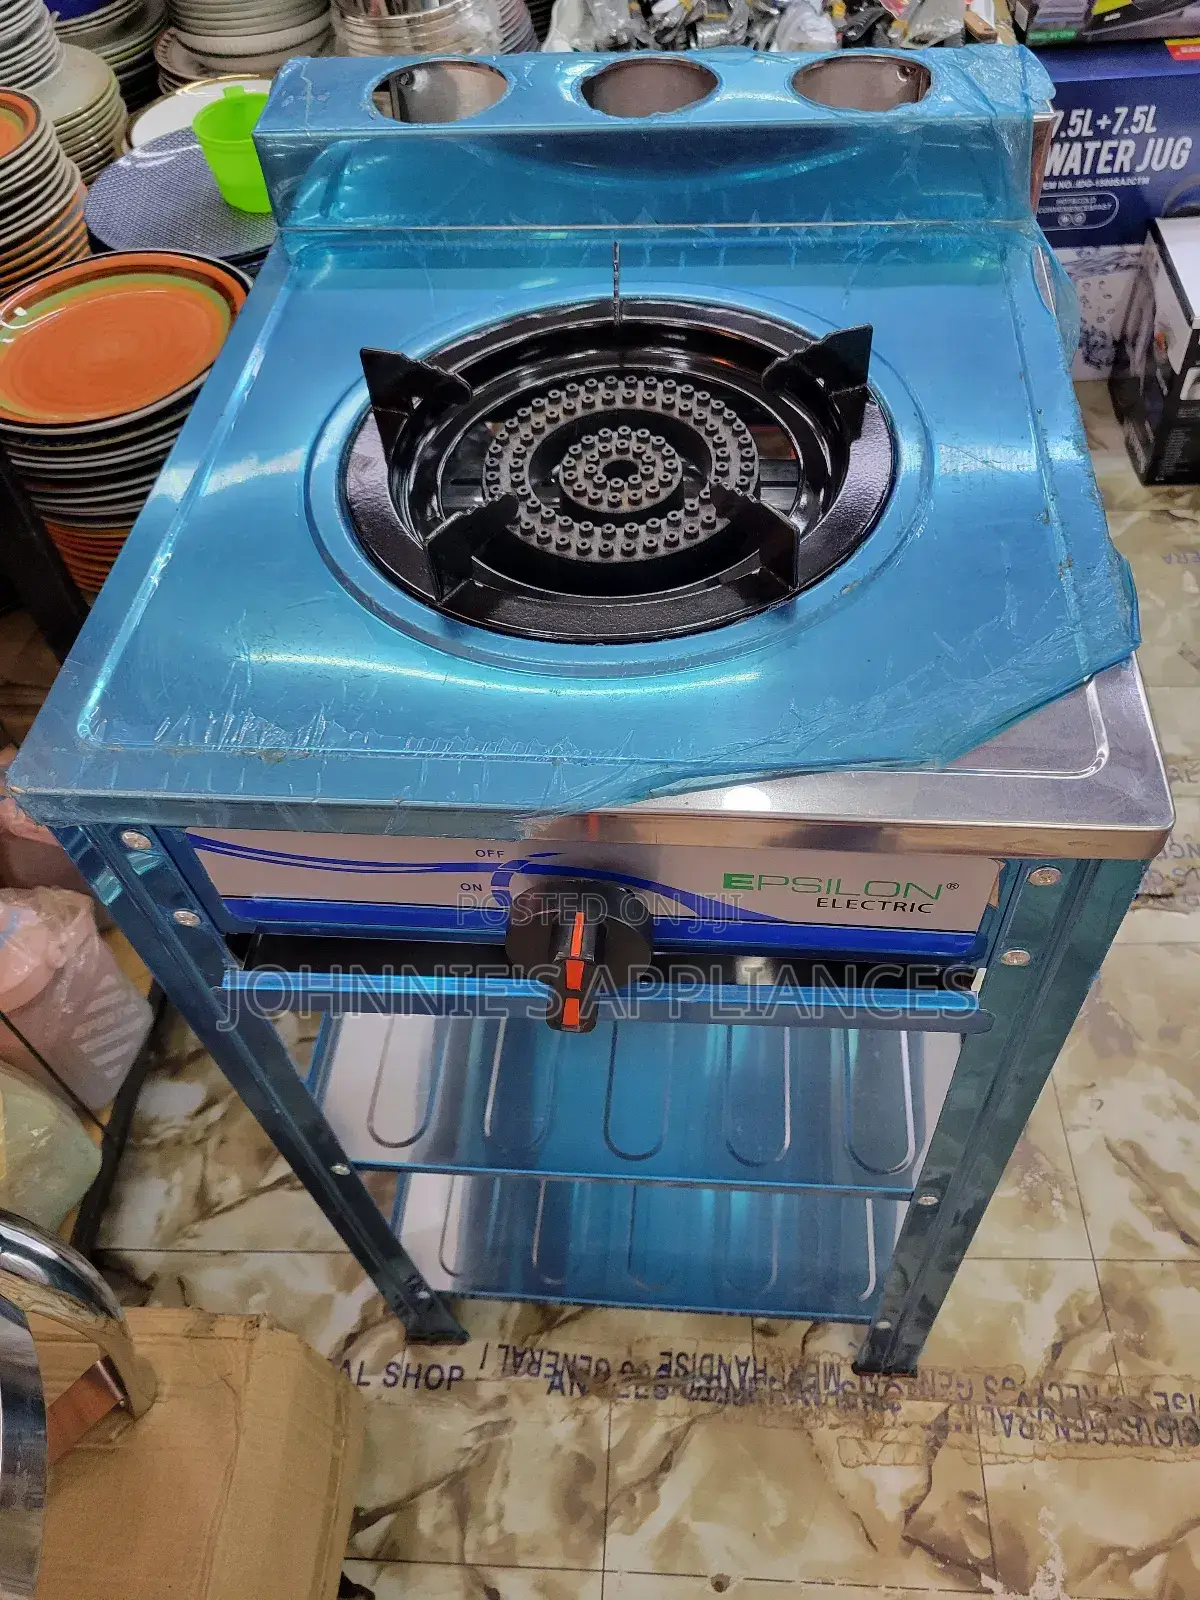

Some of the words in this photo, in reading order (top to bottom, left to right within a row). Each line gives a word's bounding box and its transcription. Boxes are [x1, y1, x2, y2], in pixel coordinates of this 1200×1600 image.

[1135, 137, 1193, 172] JUG
[475, 849, 505, 859] OFF
[460, 882, 483, 893] ON
[816, 897, 934, 914] ELECTRIC
[382, 1360, 465, 1391] SHOP
[498, 1343, 612, 1386] GENERAL
